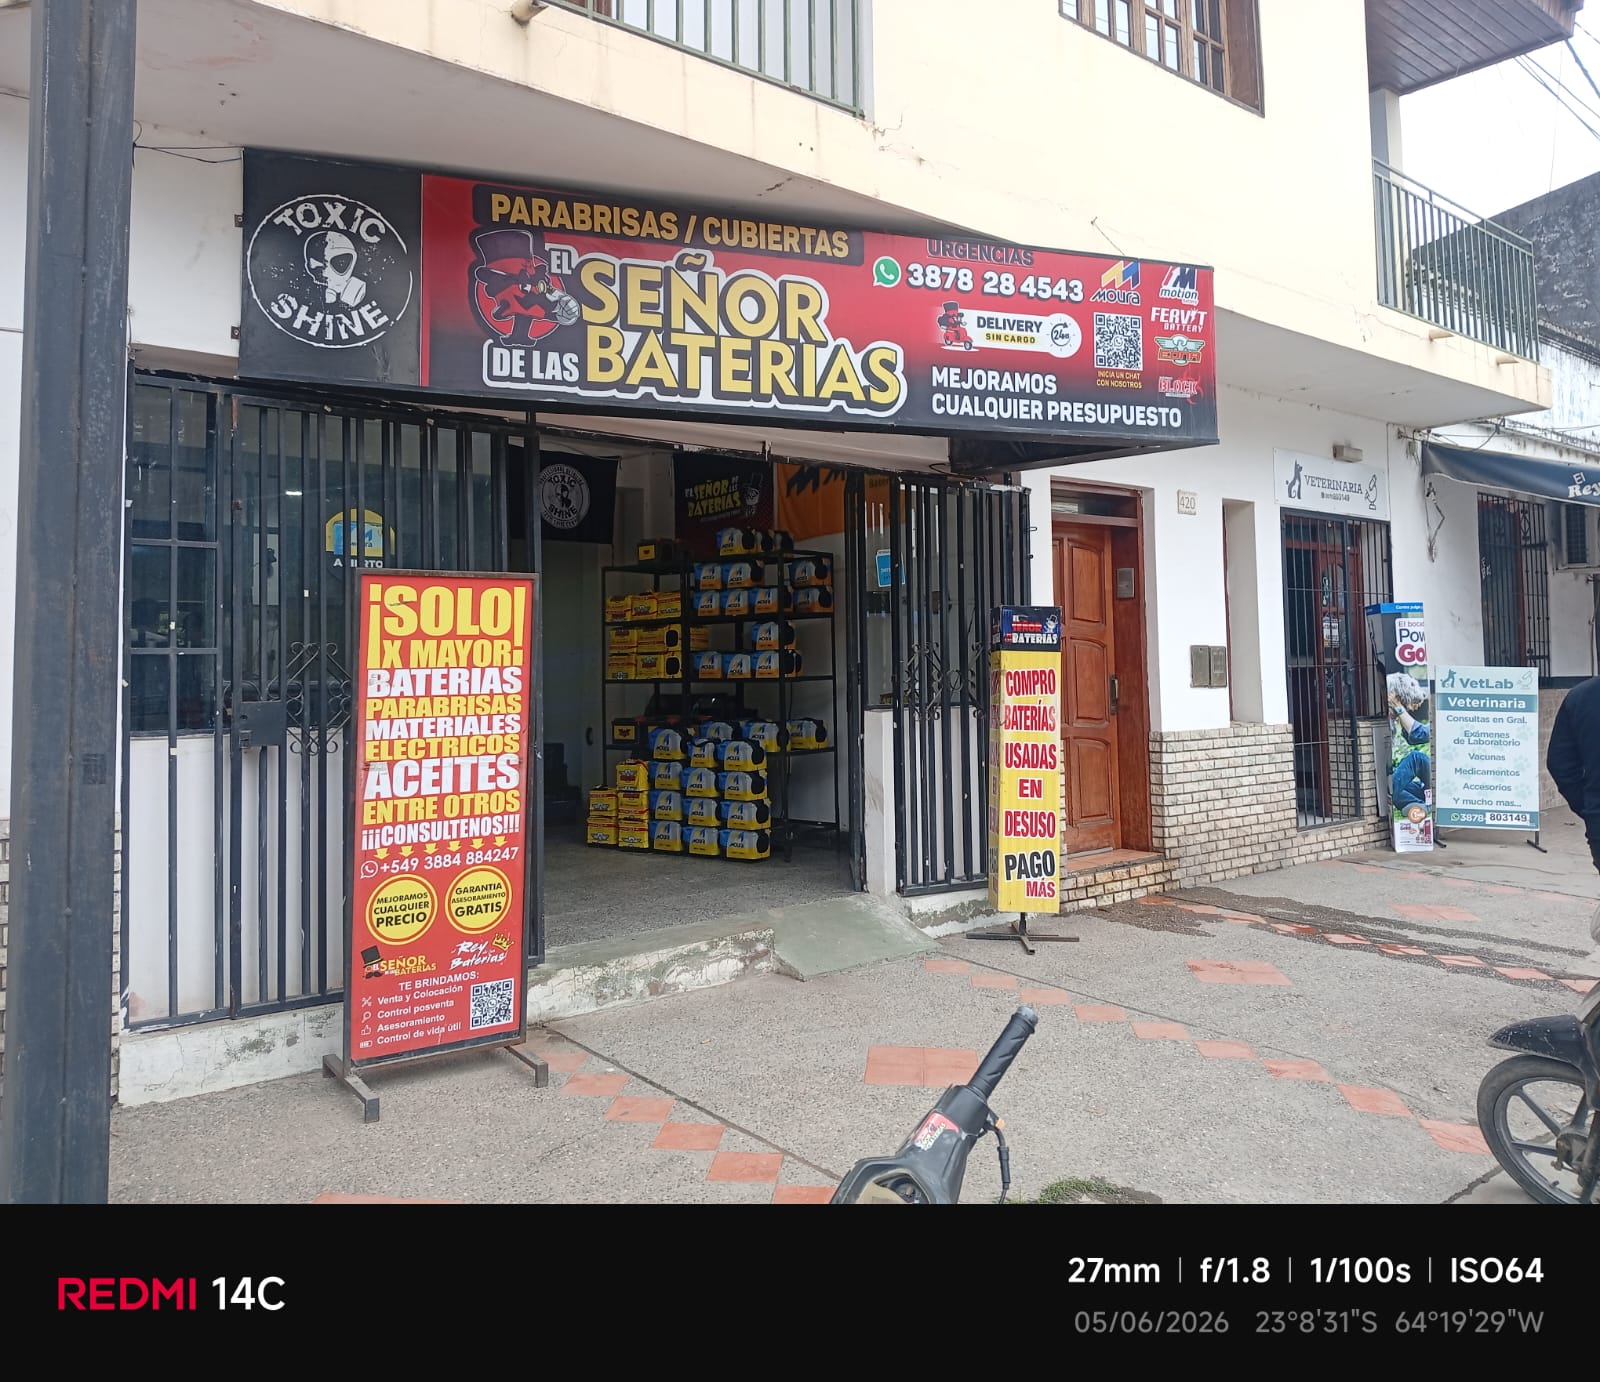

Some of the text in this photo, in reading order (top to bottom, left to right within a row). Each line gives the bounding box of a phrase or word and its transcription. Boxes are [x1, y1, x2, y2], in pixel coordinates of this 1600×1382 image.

[273, 200, 387, 244] TOXIC
[491, 193, 849, 258] PARABRISAS / CUBIERTAS
[926, 238, 1035, 267] URGENCIAS
[907, 263, 1084, 302] 3878 28 4543
[550, 249, 828, 343] EL SEÑOR
[1160, 288, 1197, 300] motion
[270, 293, 388, 339] SHINE
[977, 316, 1043, 333] DELIVERY
[1164, 323, 1203, 333] BATTERY
[986, 333, 1036, 344] SIN CARGO
[493, 326, 902, 405] DE LAS BATERIAS
[1098, 370, 1115, 379] INICIA
[1125, 372, 1141, 380] CHAT
[931, 366, 1057, 395] MEJORAMOS
[1097, 379, 1142, 389] CON NOSOTROS
[931, 393, 1182, 428] CUALQUIER PRESUPUESTO
[693, 479, 731, 501] SEÑOR
[1304, 475, 1363, 494] VETERINARIA
[548, 504, 577, 519] SHINE
[1180, 495, 1196, 509] 420
[382, 640, 402, 668] X
[367, 667, 522, 697] BATERIAS
[1005, 669, 1056, 696] COMPRO
[1459, 678, 1514, 689] VetLab
[366, 694, 522, 720] PARABRISAS
[1448, 697, 1526, 709] Veterinaria
[1004, 700, 1056, 731] BATERÍAS
[1447, 715, 1490, 723] Consultas
[1505, 716, 1527, 724] Gral.
[366, 714, 521, 740] MATERIALES
[1464, 730, 1510, 739] Exámenes
[366, 734, 520, 761] ELECTRICOS
[1454, 737, 1520, 746] de Laboratorio
[1005, 743, 1057, 769] USADAS
[1468, 753, 1506, 761] Vacunas
[364, 753, 520, 800] ACEITES
[1455, 768, 1520, 777] Medicamentos
[1019, 779, 1042, 798] EN
[1463, 782, 1512, 792] Accesorios
[363, 789, 520, 825] ENTRE OTROS
[1462, 798, 1494, 806] mucho
[1004, 811, 1056, 838] DESUSO
[1490, 813, 1527, 823] 803149
[362, 814, 520, 850] ¡¡¡CONSULTENOS!!!
[380, 846, 519, 873] +549 3884 884247
[1004, 850, 1056, 881] PAGO
[455, 882, 502, 895] GARANTIA
[1026, 878, 1056, 897] MÁS
[376, 892, 428, 905] MEJORAMOS
[451, 891, 506, 904] ASESORAMIENTO
[374, 901, 430, 915] CUALQUIER
[455, 901, 502, 918] GRATIS
[376, 912, 427, 928] PRECIO
[380, 954, 427, 972] SEÑOR
[399, 970, 479, 991] TE BRINDAMOS:
[378, 985, 463, 1006] Venta y Colocación
[377, 999, 454, 1019] Control posventa
[377, 1014, 445, 1032] Asesoramiento
[377, 1022, 462, 1045] Control de vida útil
